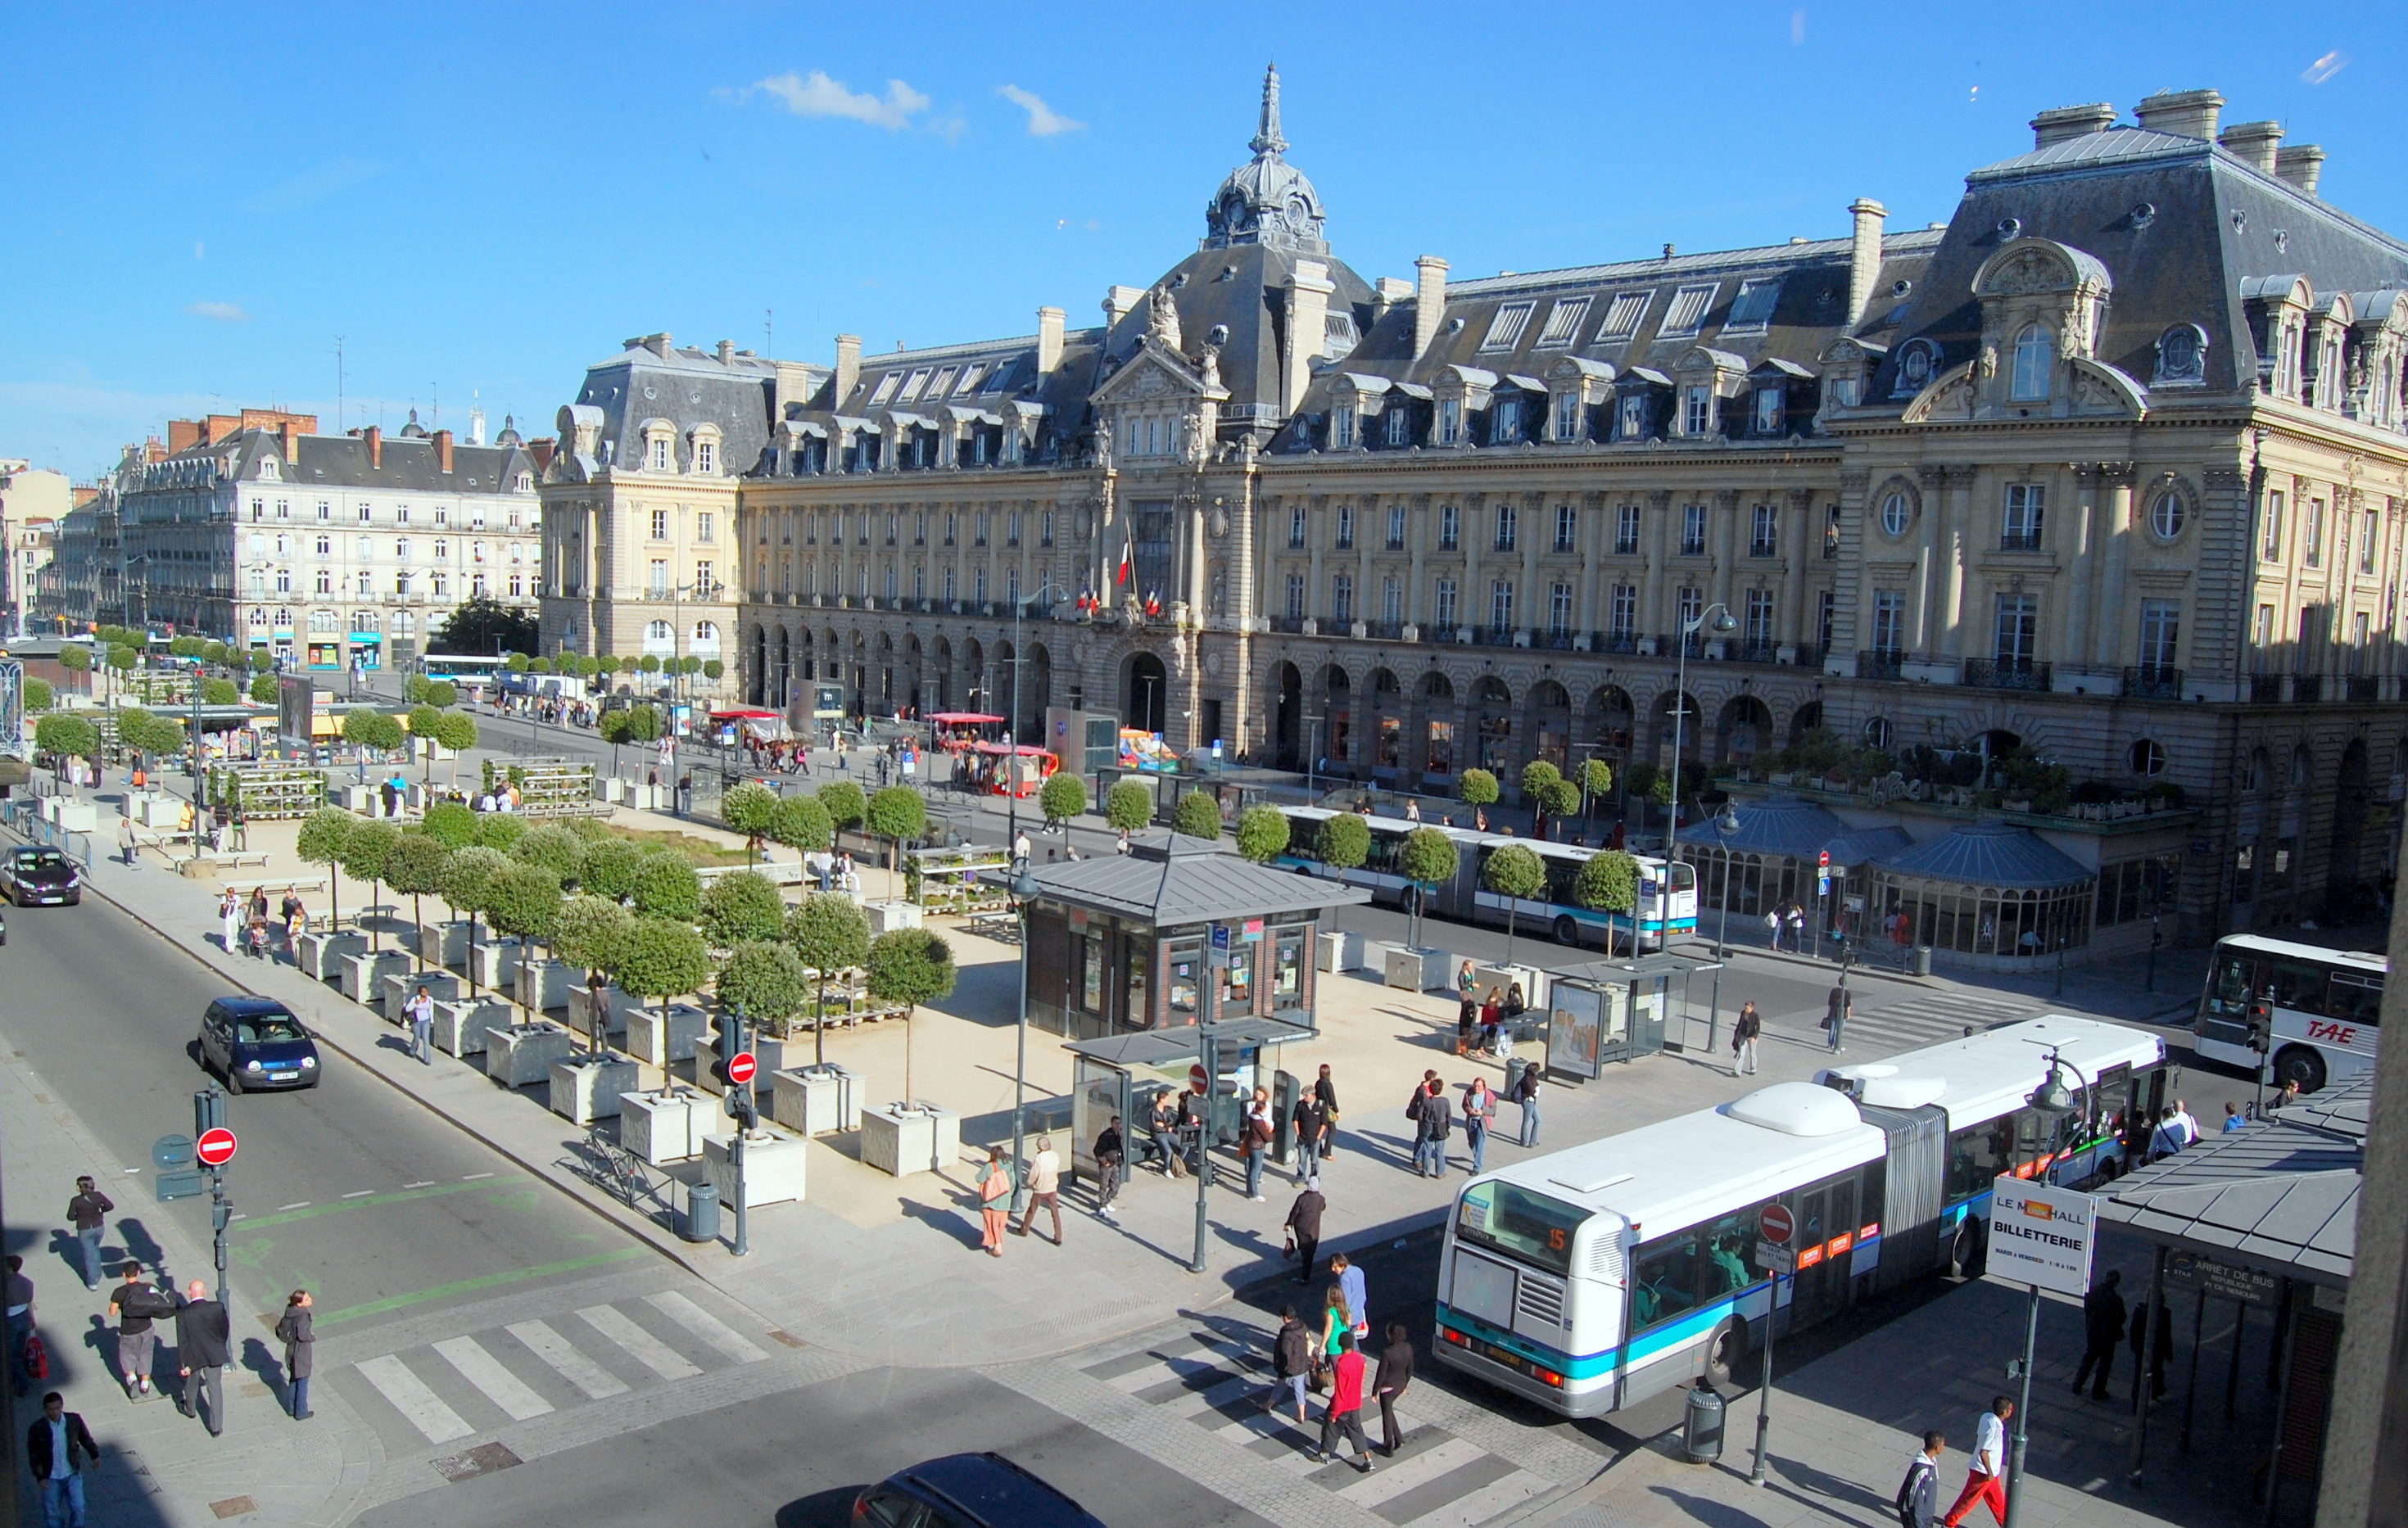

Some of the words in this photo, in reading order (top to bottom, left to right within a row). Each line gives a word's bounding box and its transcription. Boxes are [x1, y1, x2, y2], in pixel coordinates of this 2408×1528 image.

[2307, 1020, 2356, 1044] TAE
[1997, 1196, 2014, 1209] LE
[1549, 1227, 1566, 1250] 15
[1994, 1221, 2083, 1251] BILLETTERIE
[2234, 1270, 2248, 1282] DE
[2252, 1275, 2274, 1288] BUS
